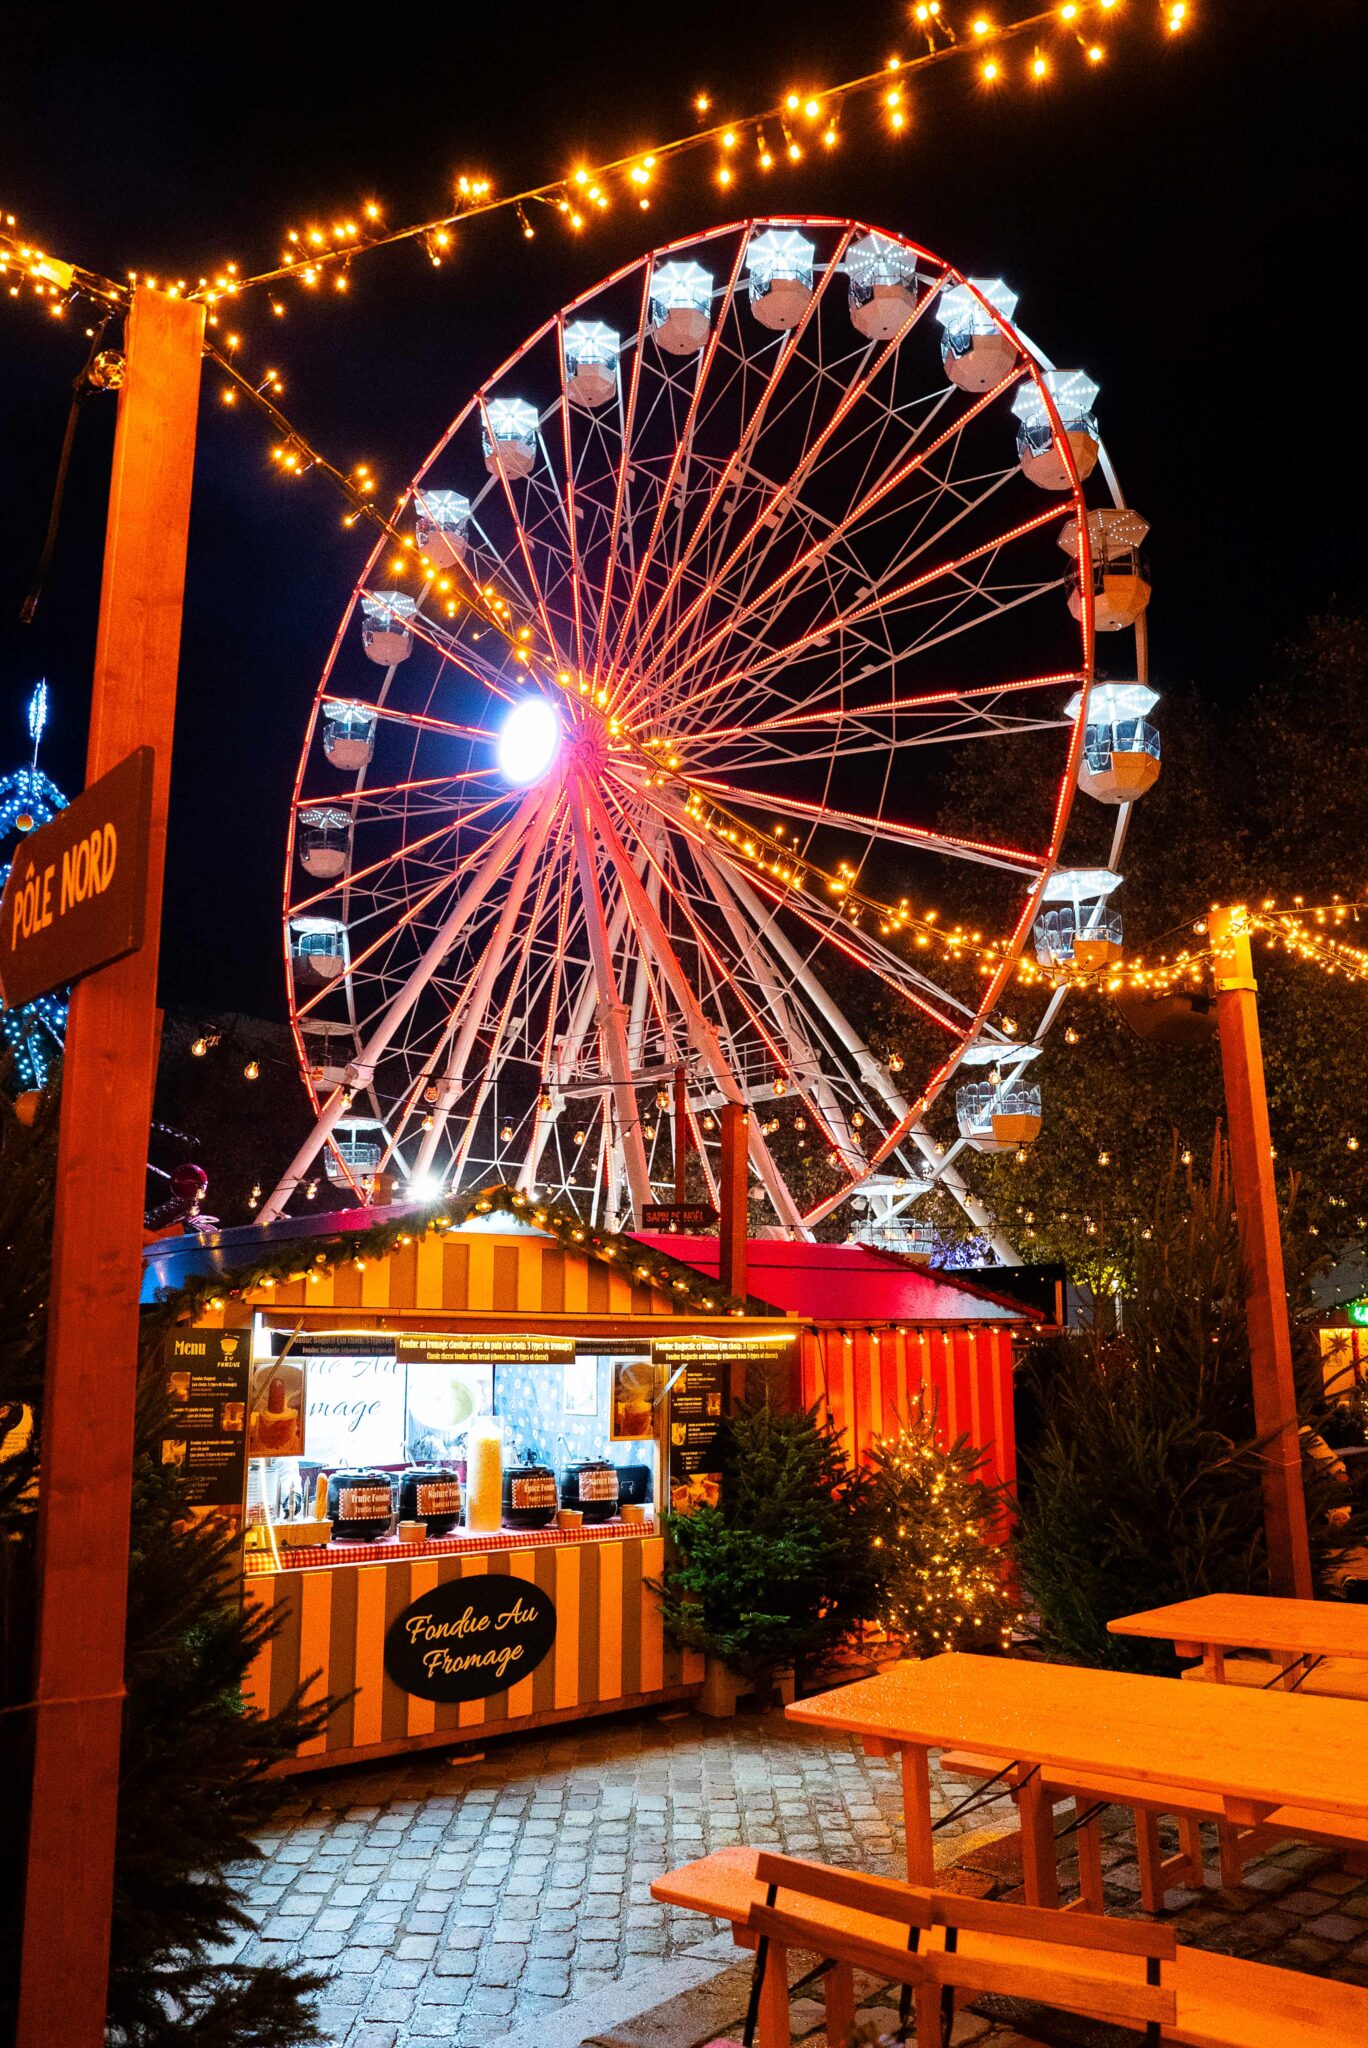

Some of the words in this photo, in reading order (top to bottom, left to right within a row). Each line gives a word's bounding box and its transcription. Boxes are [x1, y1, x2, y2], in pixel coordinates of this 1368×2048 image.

[12, 861, 55, 951] PÔLE
[61, 823, 117, 916] NORD
[174, 1340, 206, 1356] Menu
[400, 1339, 419, 1349] Fondue
[405, 1605, 491, 1644] Fondue
[494, 1597, 539, 1631] Au
[422, 1644, 525, 1678] Fromage
